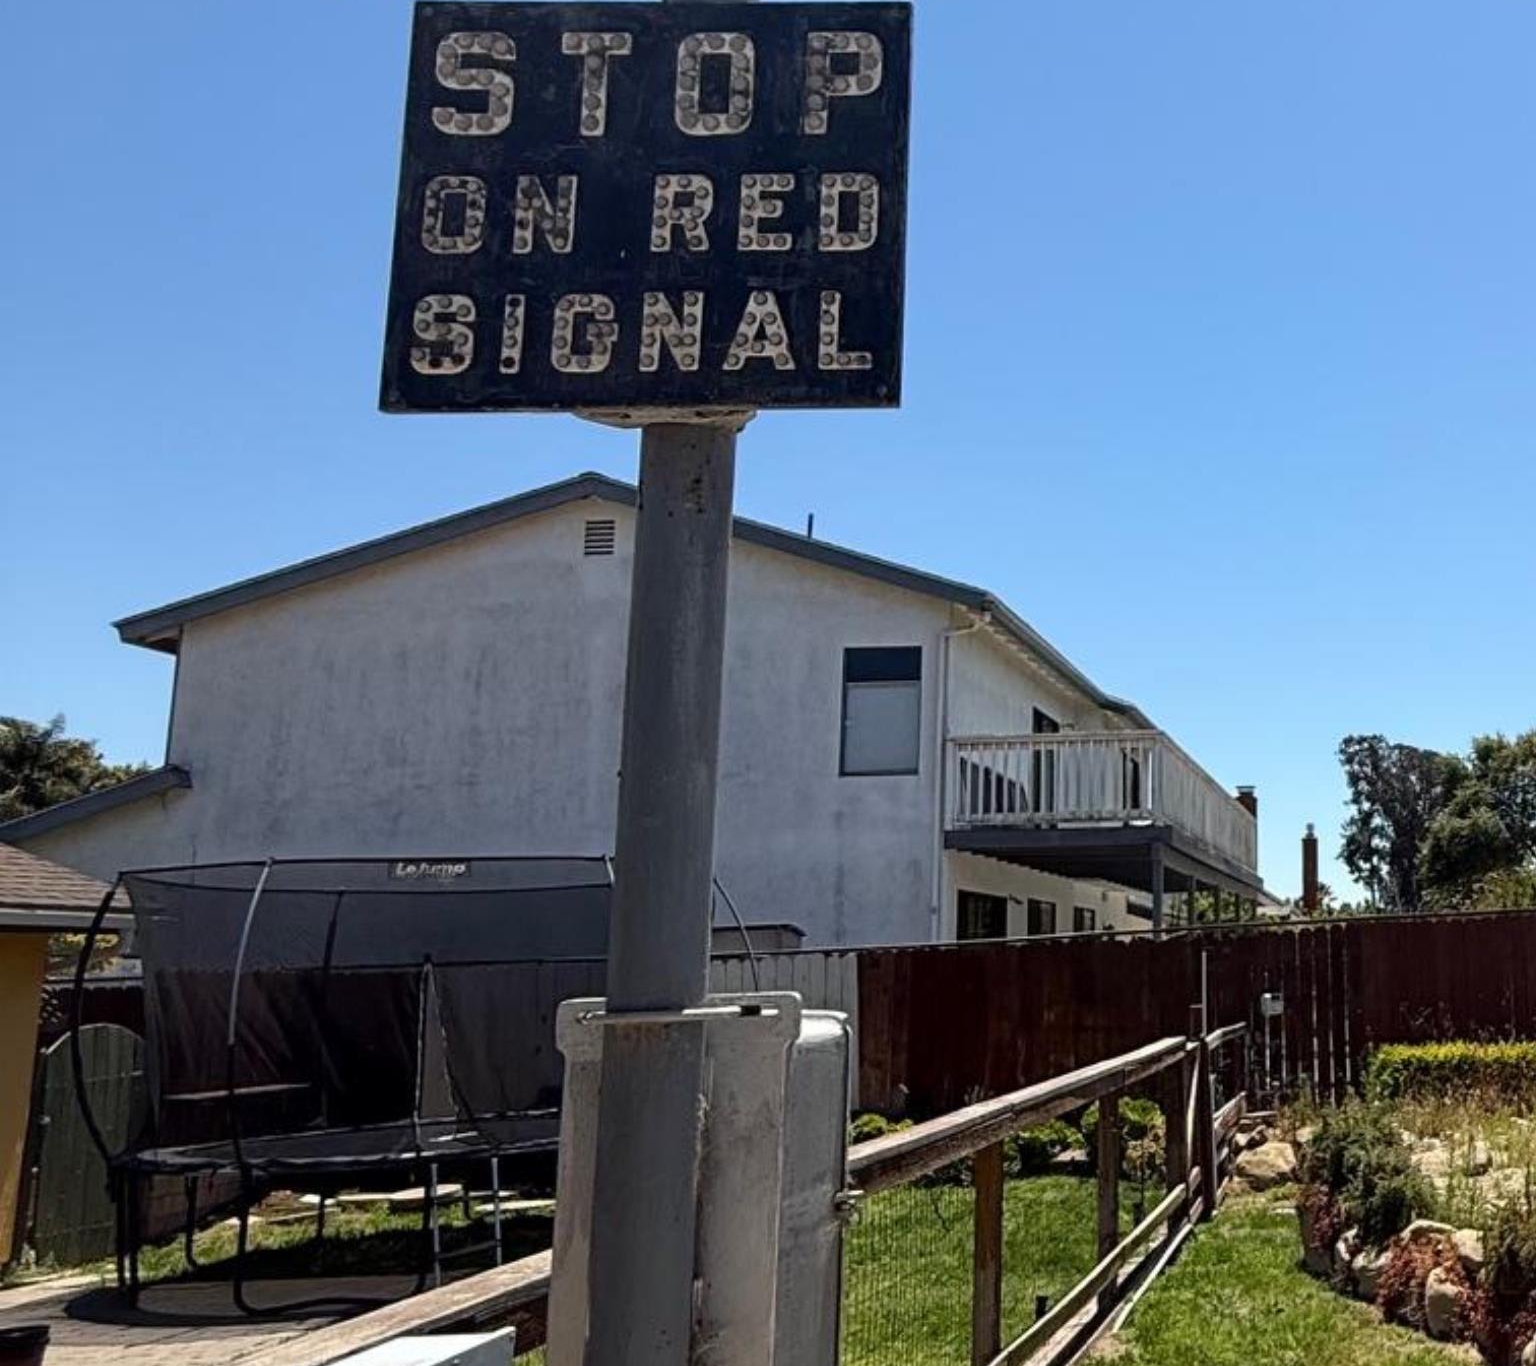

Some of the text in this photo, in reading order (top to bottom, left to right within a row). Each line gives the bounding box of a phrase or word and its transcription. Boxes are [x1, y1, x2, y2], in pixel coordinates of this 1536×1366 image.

[431, 31, 884, 135] STOP
[421, 172, 880, 254] ON RED
[409, 290, 873, 375] SIGNAL
